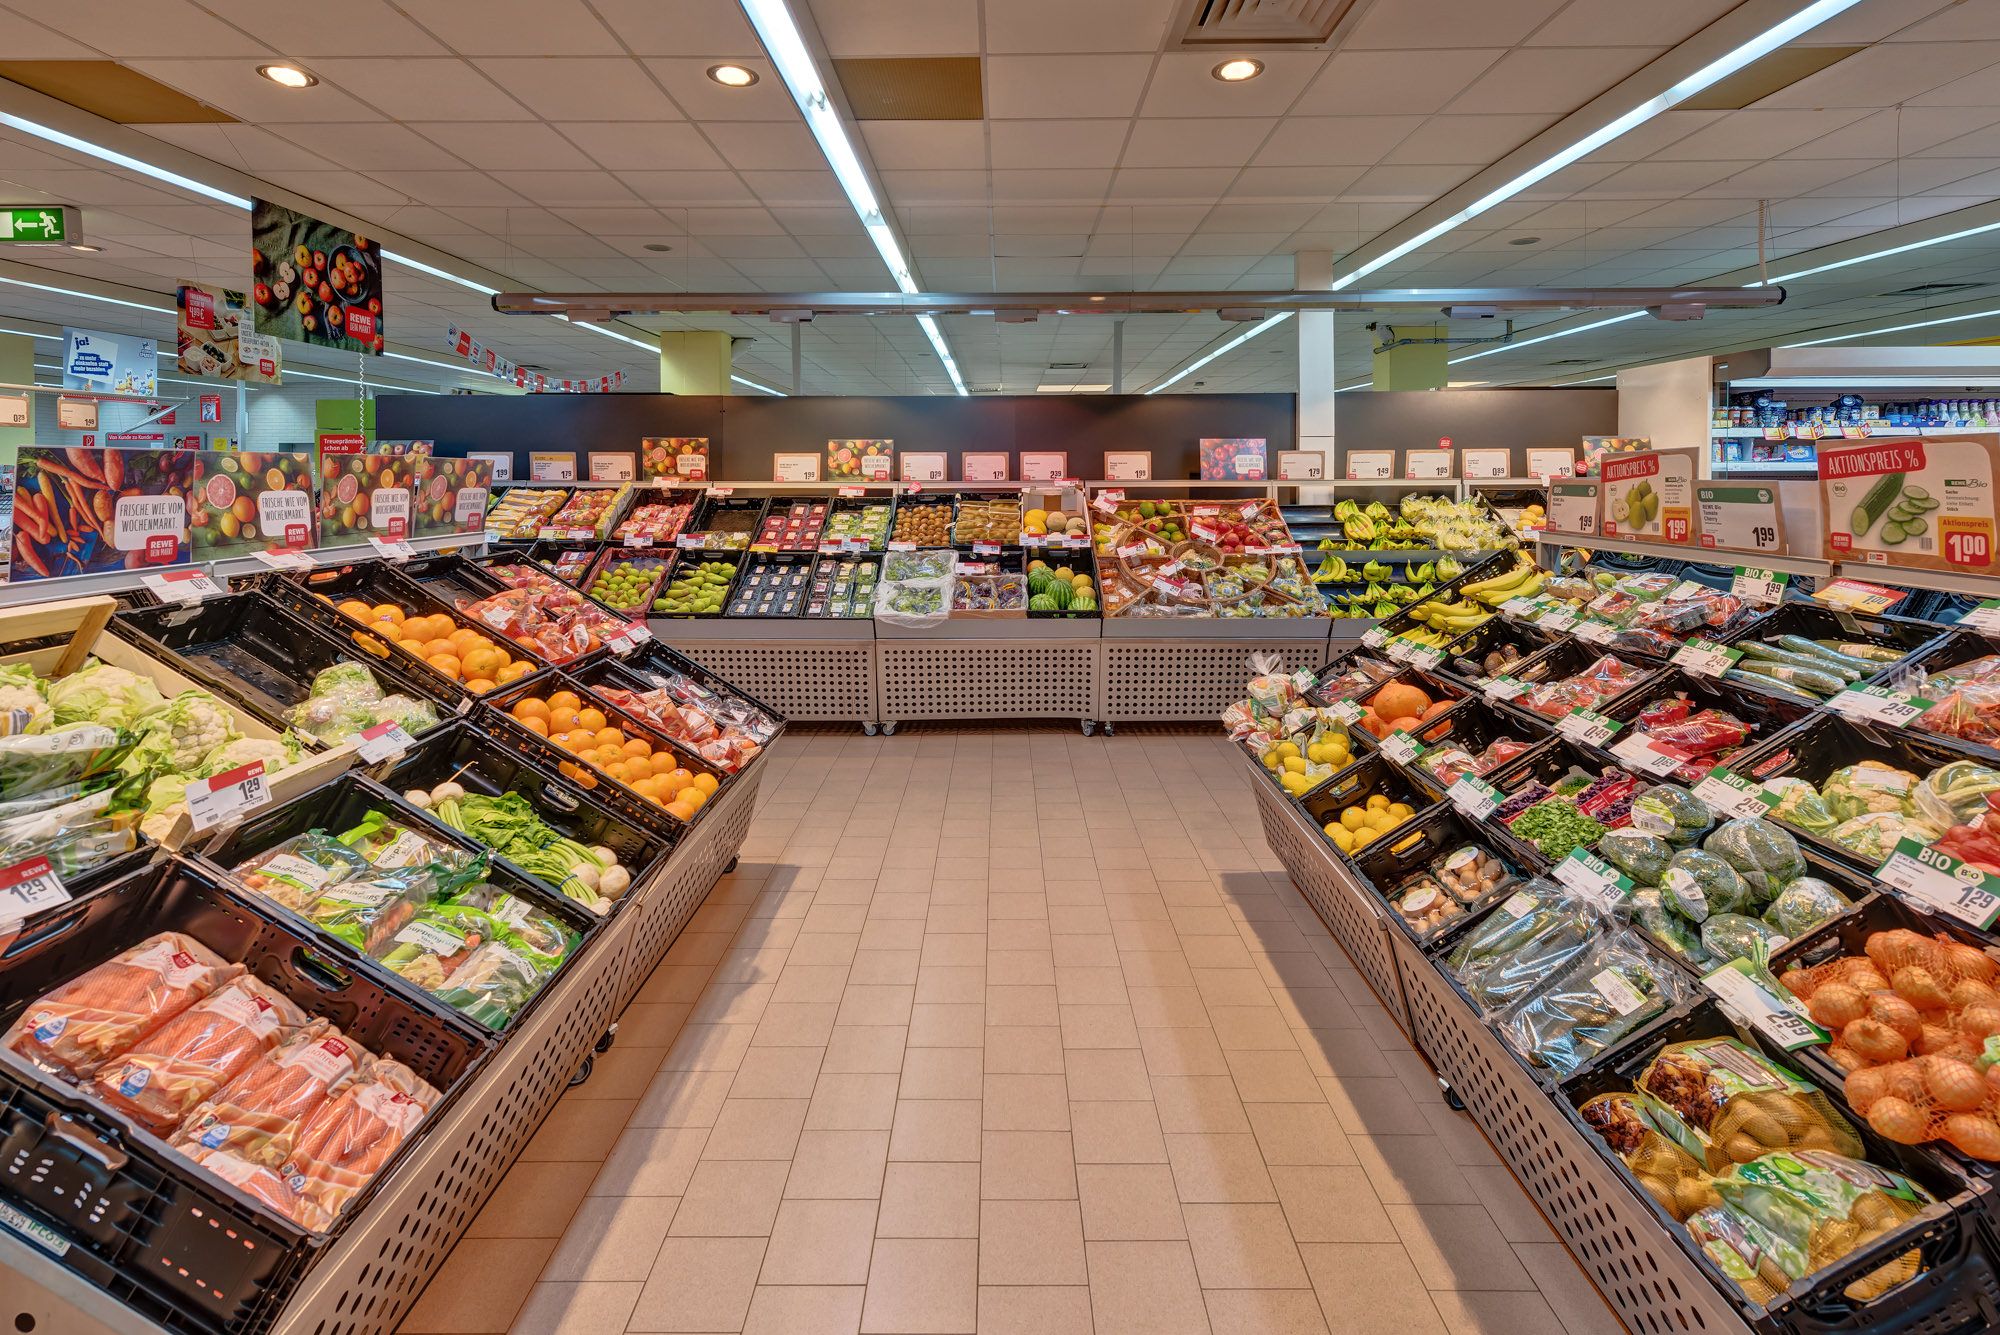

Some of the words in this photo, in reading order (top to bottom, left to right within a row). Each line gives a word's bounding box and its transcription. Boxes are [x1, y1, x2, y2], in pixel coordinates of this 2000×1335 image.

[350, 312, 372, 326] REWE
[74, 336, 90, 350] ja!
[1828, 449, 1902, 475] AKTIONSPREIS
[1904, 450, 1919, 468] %
[496, 469, 508, 478] 1.99
[561, 470, 572, 479] 1.79
[993, 470, 1004, 479] 1.79
[1050, 470, 1062, 479] 2.39
[1308, 468, 1320, 476] 1.79
[1376, 468, 1388, 476] 1.49
[1436, 467, 1448, 476] 1.05
[1606, 460, 1646, 479] AKTIONSPREIS
[1967, 478, 1988, 488] Bio
[374, 494, 390, 503] FRISCHE
[1700, 490, 1714, 499] BIO
[262, 497, 284, 508] FRISCHE
[285, 497, 295, 507] WIE
[296, 496, 308, 506] VOM
[120, 503, 150, 516] FRISCHE
[152, 503, 166, 515] WIE
[168, 502, 183, 514] VOM
[264, 508, 306, 521] WOCHENMARKT.
[122, 518, 178, 532] WOCHENMARKT.
[1578, 516, 1592, 530] 1.99
[1942, 520, 1989, 528] Aktionspreis
[288, 528, 305, 536] REWE
[1667, 520, 1686, 540] 1.99
[1752, 526, 1774, 547] 1.99
[150, 540, 174, 549] REWE
[1948, 534, 1986, 562] 1.00
[1744, 568, 1759, 578] BIO
[190, 578, 209, 590] 0.79
[1765, 582, 1782, 596] 1.99
[1836, 581, 1889, 594] AKTIONSPREIS
[1862, 594, 1888, 604] 1.00
[1695, 640, 1713, 650] BIO
[1704, 654, 1728, 668] 2.49
[1862, 685, 1889, 697] BIO
[1580, 710, 1596, 720] BIO
[1880, 702, 1916, 717] 2.49
[1583, 726, 1610, 739] 0.49
[1651, 756, 1677, 768] 0.69
[247, 766, 264, 776] REWE
[1470, 776, 1486, 791] BIO
[1722, 772, 1744, 788] BIO
[238, 777, 260, 801] 1.29
[1476, 796, 1492, 810] 1.99
[1734, 798, 1766, 814] 2.49
[1582, 854, 1603, 872] BIO
[1917, 846, 1952, 871] BIO
[20, 863, 48, 878] REWE
[1960, 869, 1979, 880] BIO
[10, 878, 48, 904] 1.29
[1956, 886, 1995, 909] 1.29
[1766, 1010, 1812, 1036] 2.99
[328, 1038, 346, 1051] REWE
[28, 1220, 54, 1241] IFCO
